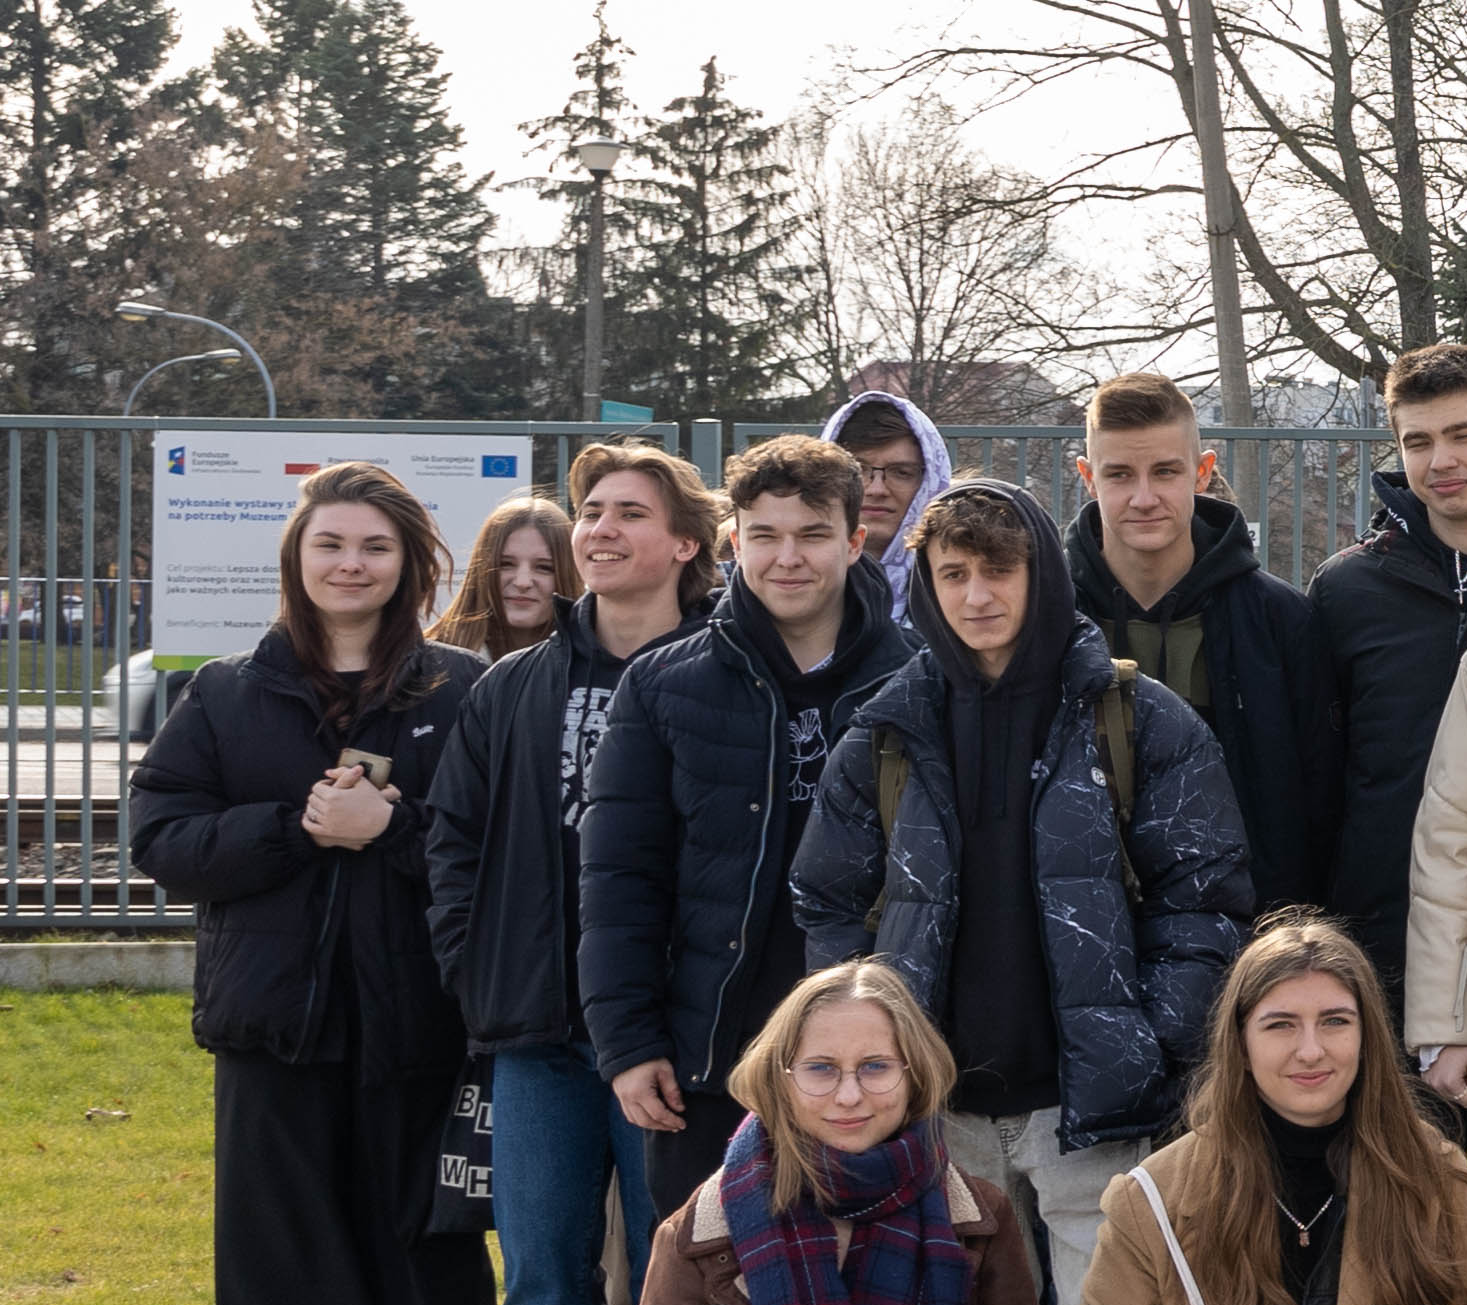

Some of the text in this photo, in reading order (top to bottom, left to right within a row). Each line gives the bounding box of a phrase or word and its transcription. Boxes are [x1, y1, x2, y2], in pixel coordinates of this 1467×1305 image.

[168, 498, 231, 510] Wykonanie
[234, 499, 284, 512] wystawy
[168, 511, 288, 523] na potrzeby Muzeum
[227, 565, 259, 574] Lepsza
[167, 575, 227, 585] kulturowego
[167, 585, 187, 595] jako
[223, 620, 264, 629] Muzeum
